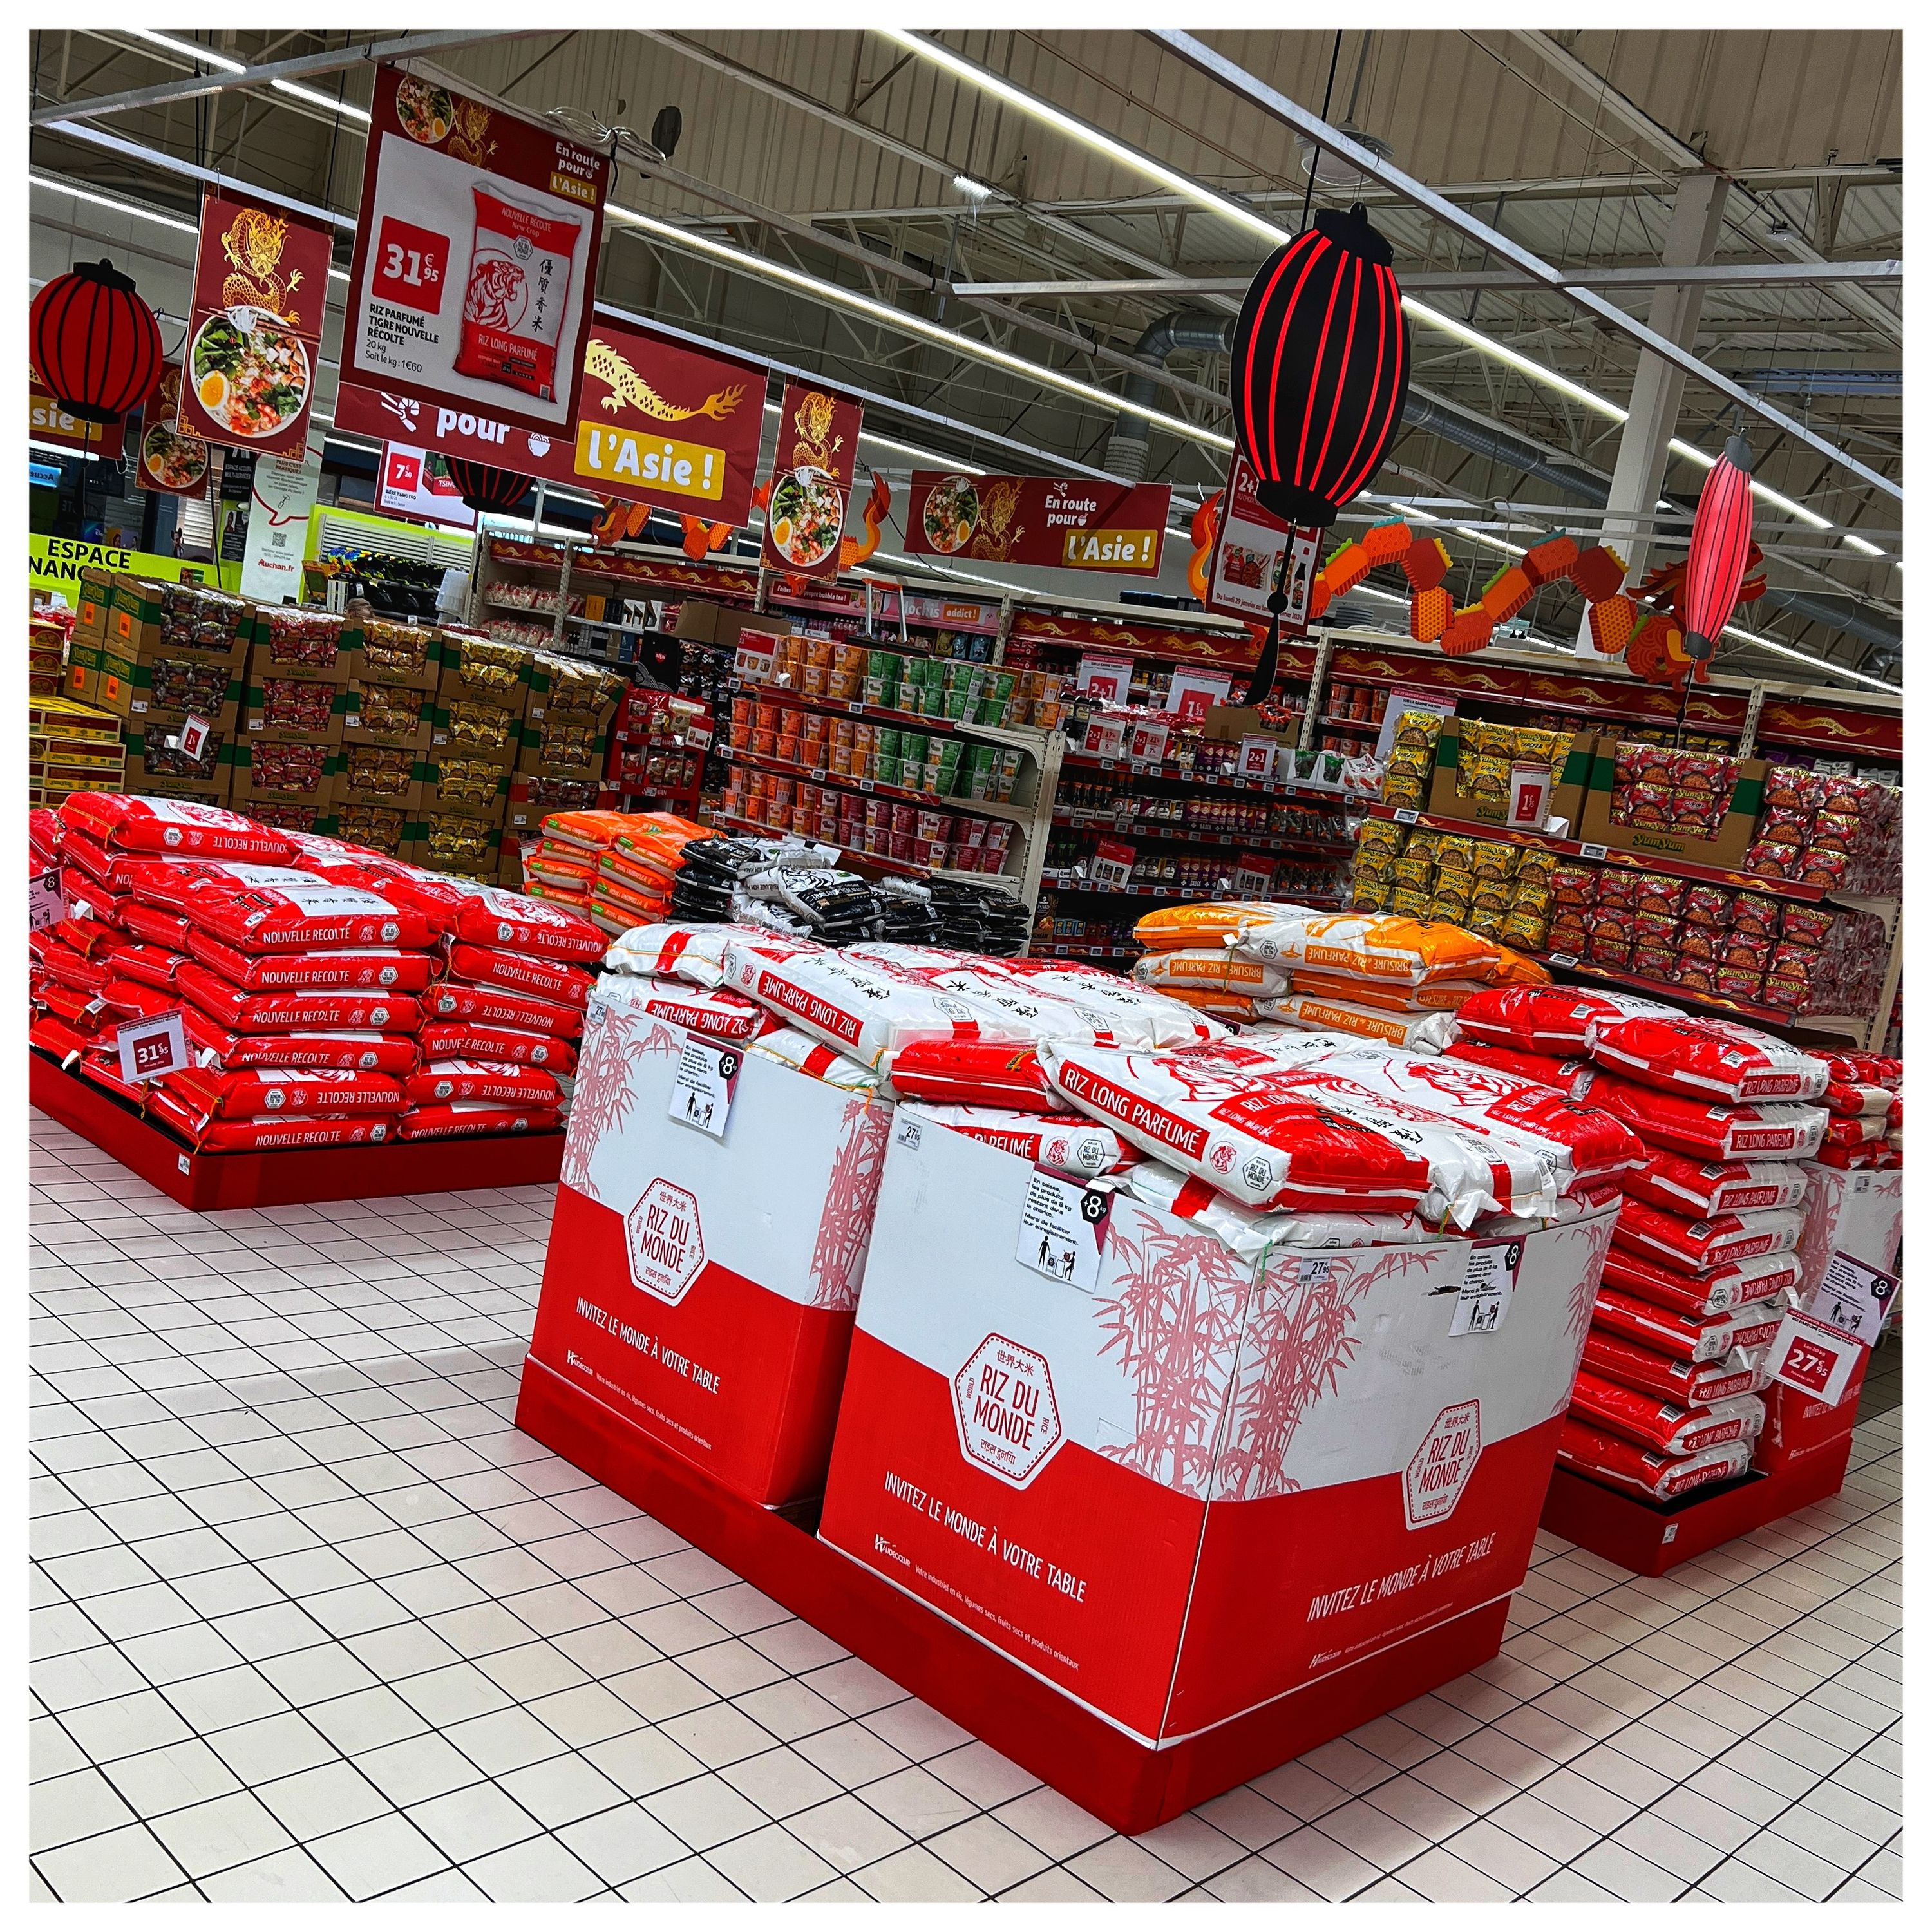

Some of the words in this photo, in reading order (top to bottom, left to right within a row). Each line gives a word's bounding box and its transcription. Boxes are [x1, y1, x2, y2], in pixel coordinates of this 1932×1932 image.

[556, 141, 569, 157] En
[571, 150, 600, 170] route
[558, 158, 585, 176] pour
[591, 189, 594, 200] !
[502, 207, 529, 223] NOUVELLE
[530, 216, 552, 232] RÉCOLTE
[526, 227, 540, 238] Crop
[370, 303, 384, 315] RIZ
[385, 308, 424, 328] PARFUMÉ
[368, 327, 404, 345] RÉCOLTE
[369, 316, 394, 330] TIGRE
[395, 323, 439, 343] NOUVELLE
[366, 339, 376, 348] 20
[377, 343, 386, 353] kg
[478, 334, 488, 346] RIZ
[491, 338, 507, 352] LONG
[509, 343, 538, 361] PARFUMÉ
[365, 350, 379, 360] Soit
[381, 354, 387, 363] le
[402, 360, 422, 373] 1€60
[435, 408, 511, 444] pour
[588, 430, 693, 487] l'Asie
[702, 453, 714, 491] !
[1045, 495, 1061, 509] En
[1063, 498, 1097, 511] route
[1047, 513, 1077, 527] pour
[48, 538, 131, 569] ESPACE
[1068, 535, 1135, 561] l'Asie
[1142, 536, 1150, 562] !
[258, 558, 294, 572] Auchan.fr
[777, 585, 791, 594] Faites
[819, 592, 835, 601] bubble
[1216, 592, 1223, 601] Du
[1241, 600, 1255, 610] janvier
[946, 609, 972, 618] addict
[263, 931, 310, 943] NOUVELLE
[312, 927, 350, 941] RECOLTE
[1308, 947, 1350, 962] PARFUMÉ
[1171, 961, 1206, 974] PARFUMÉ
[1208, 964, 1220, 974] RIZ
[1229, 966, 1262, 978] BRISURE
[1373, 958, 1410, 972] BRISURE
[261, 971, 310, 983] NOUVELLE
[312, 971, 350, 982] RECOLTE
[493, 962, 531, 982] NOUVELLE
[531, 976, 562, 991] RECOLTE
[763, 975, 810, 1011] PARFUMÉ
[252, 1010, 299, 1023] NOUVELLE
[302, 1010, 340, 1022] RECOLTE
[811, 1001, 838, 1026] LONG
[1302, 1003, 1341, 1027] PARFUMÉ
[1343, 1014, 1357, 1028] RIZ
[701, 1015, 729, 1033] LONG
[838, 1016, 858, 1039] RIZ
[1366, 1019, 1405, 1038] BRISURE
[317, 1092, 354, 1104] RECOLTE
[357, 1092, 399, 1103] NOUVELLE
[1240, 1098, 1271, 1112] RIZ
[1065, 1068, 1090, 1096] RIZ
[1090, 1082, 1128, 1117] LONG
[1132, 1103, 1202, 1153] PARFUMÉ
[1227, 1112, 1245, 1124] LONG
[255, 1133, 302, 1146] NOUVELLE
[303, 1130, 341, 1144] RECOLTE
[1737, 1134, 1748, 1148] RIZ
[1749, 1133, 1766, 1147] LONG
[1250, 1164, 1259, 1173] RIZ
[1247, 1171, 1265, 1185] MONDE
[660, 1191, 687, 1212] 世界大米
[1037, 1193, 1050, 1202] plus
[1041, 1188, 1064, 1200] produits
[1028, 1197, 1048, 1209] restent
[1050, 1206, 1063, 1215] dans
[647, 1204, 668, 1235] RIZ
[670, 1215, 689, 1245] DU
[1023, 1218, 1034, 1227] leur
[1025, 1213, 1040, 1222] Merci
[1049, 1222, 1071, 1235] faciliter
[641, 1230, 685, 1273] MONDE
[576, 1296, 608, 1329] INVITEZ
[609, 1318, 618, 1336] LE
[620, 1326, 650, 1354] MONDE
[651, 1335, 658, 1359] À
[661, 1346, 689, 1378] VOTRE
[692, 1363, 721, 1395] TABLE
[997, 1350, 1034, 1376] 世界大米
[966, 1377, 974, 1399] WORLD
[980, 1364, 1009, 1403] RIZ
[1012, 1380, 1039, 1417] DU
[974, 1395, 1035, 1451] MONDE
[1041, 1417, 1050, 1435] RICE
[1427, 1434, 1452, 1464] RIZ
[1450, 1428, 1471, 1458] DU
[1418, 1457, 1464, 1494] MONDE
[884, 1470, 927, 1512] INVITEZ
[929, 1497, 942, 1522] LE
[944, 1506, 986, 1548] MONDE
[987, 1526, 998, 1555] À
[1003, 1539, 1043, 1579] VOTRE
[1047, 1563, 1086, 1603] TABLE
[1307, 1584, 1360, 1622] INVITEZ
[1360, 1579, 1378, 1605] LE
[1377, 1565, 1421, 1600] MONDE
[1417, 1553, 1432, 1584] À
[1432, 1546, 1466, 1578] VOTRE
[1466, 1532, 1496, 1564] TABLE
[915, 1564, 927, 1578] Votre
[928, 1572, 949, 1591] industriel
[949, 1586, 956, 1595] en
[964, 1595, 983, 1614] légumes
[998, 1616, 1012, 1631] fruits
[1012, 1625, 1023, 1638] secs
[1024, 1633, 1030, 1642] et
[1031, 1636, 1053, 1655] produits
[1053, 1651, 1079, 1671] orientaux
